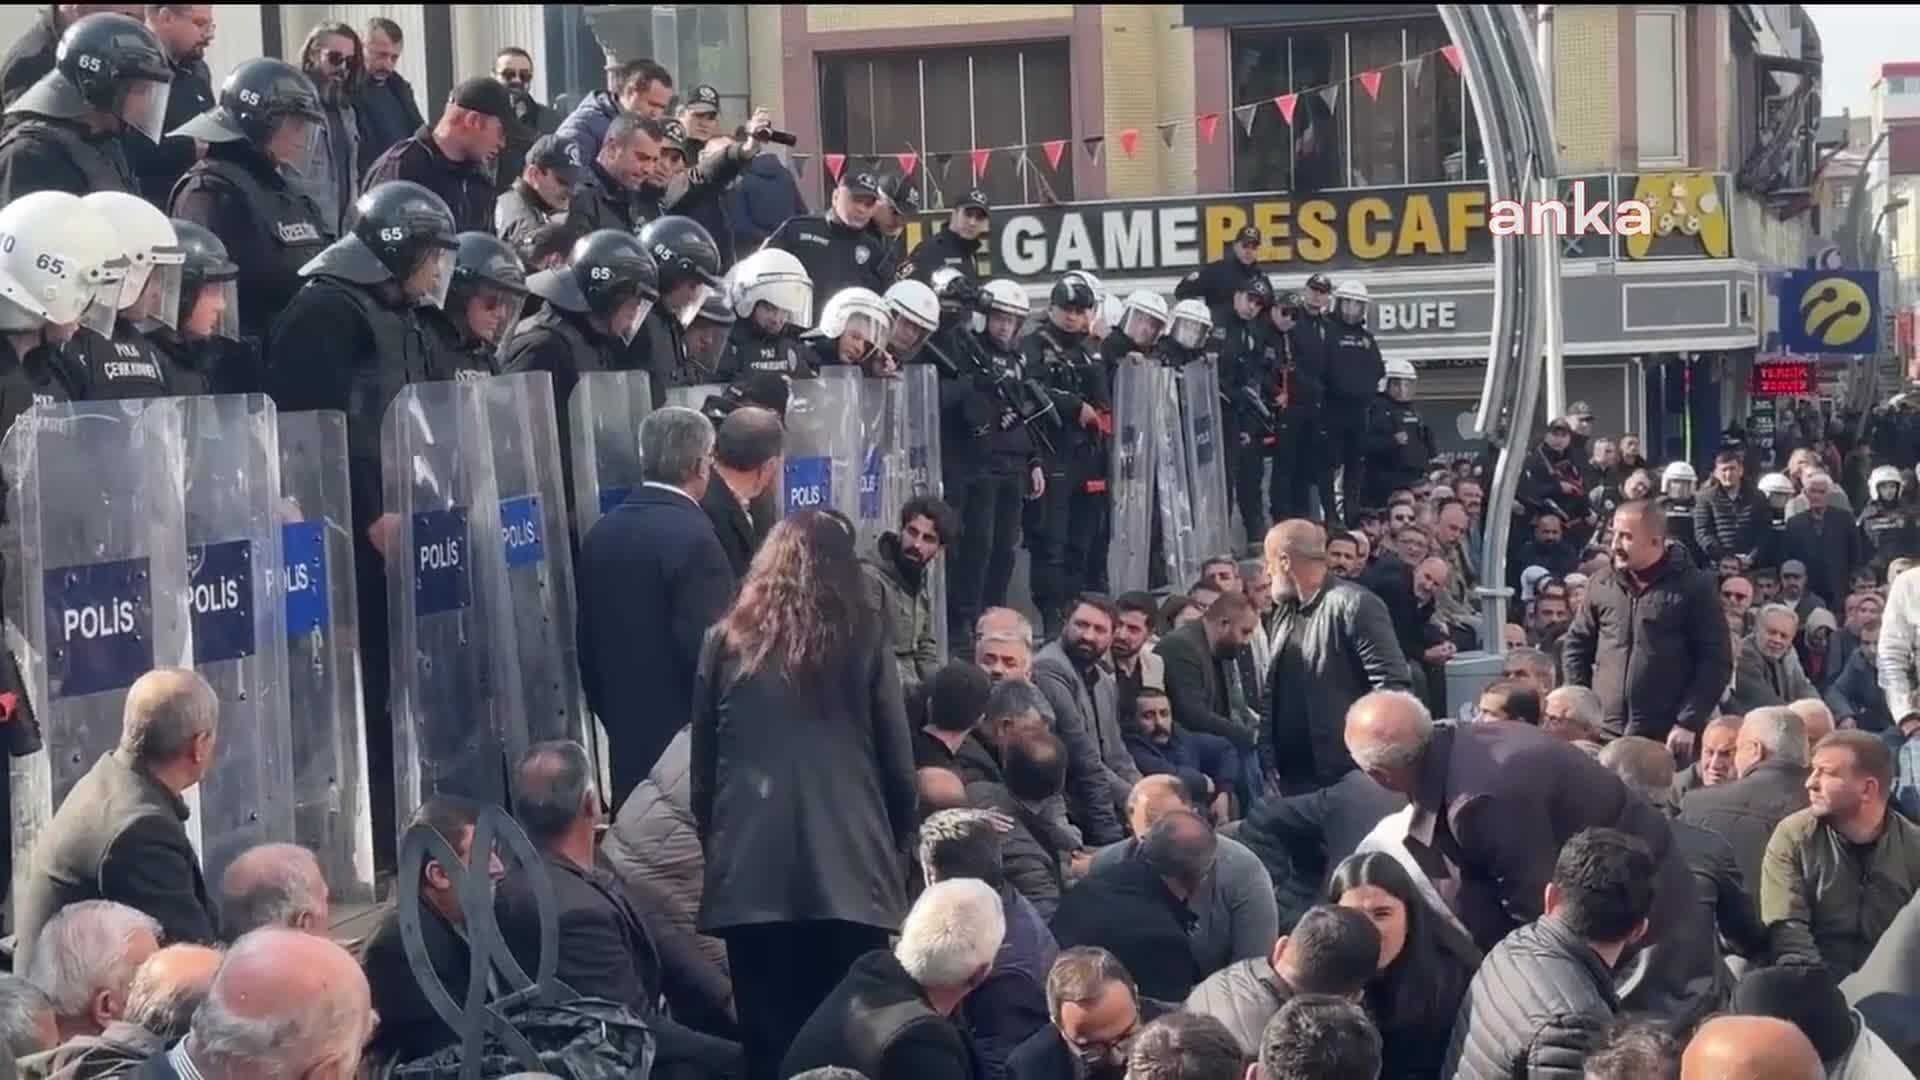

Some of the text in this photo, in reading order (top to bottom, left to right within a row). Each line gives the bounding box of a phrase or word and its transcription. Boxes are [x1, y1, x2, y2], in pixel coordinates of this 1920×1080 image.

[79, 54, 101, 72] 65
[240, 88, 260, 106] 65
[381, 227, 402, 241] 65
[1001, 206, 1199, 275] GAME
[1205, 199, 1337, 264] PES
[1347, 192, 1489, 260] CAF
[655, 243, 673, 260] 65
[36, 253, 65, 275] 65
[591, 266, 611, 280] 65
[1379, 302, 1456, 330] BUFE
[420, 537, 460, 571] POLİS
[64, 596, 134, 642] POLİS
